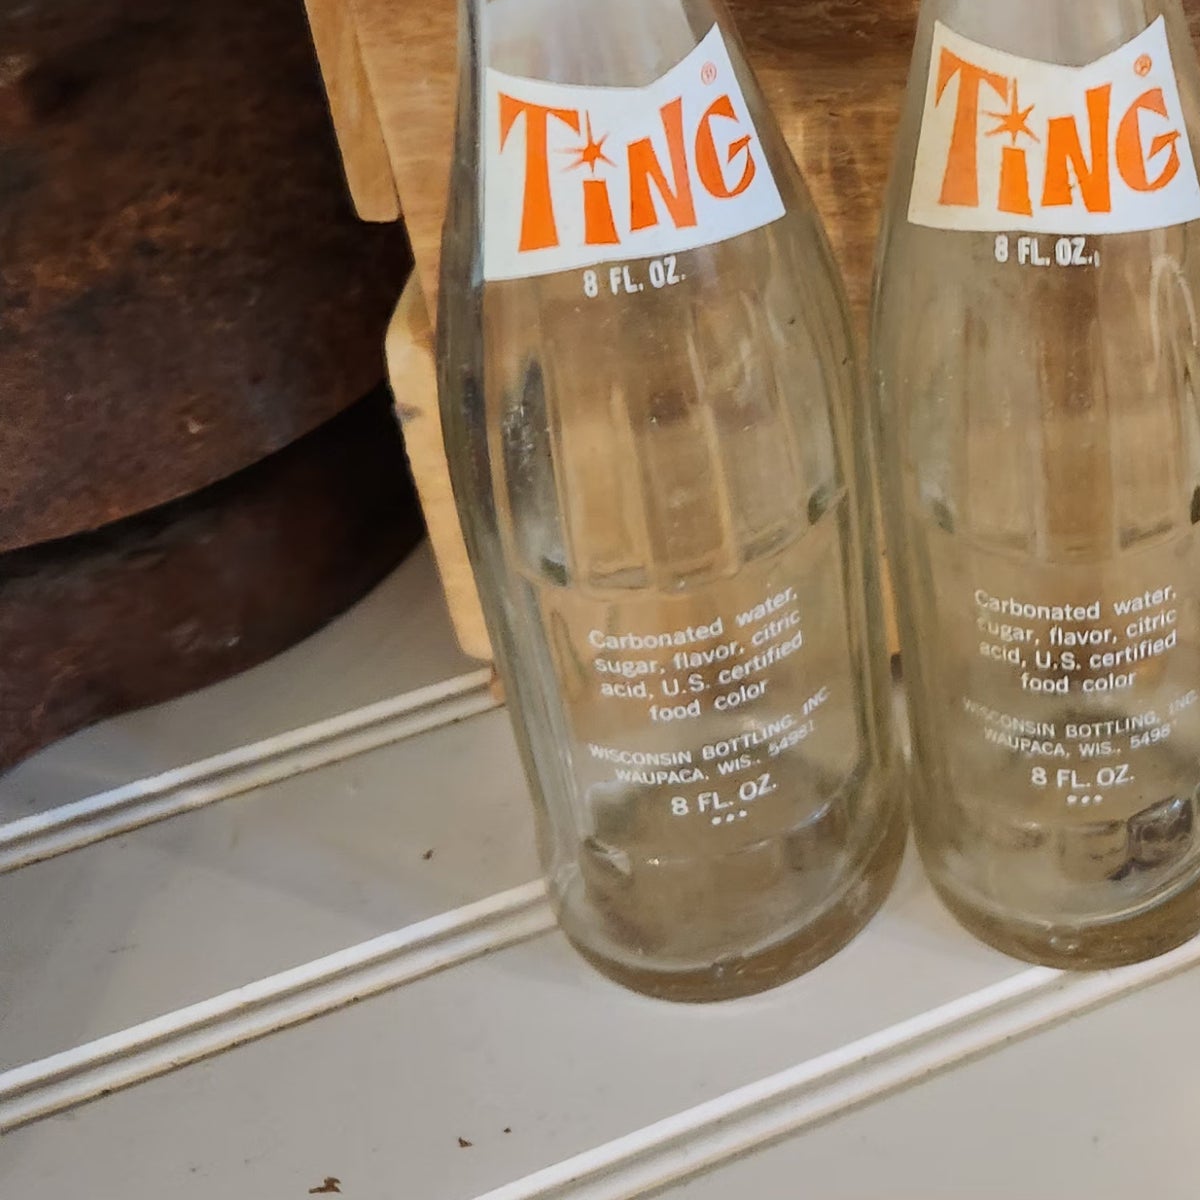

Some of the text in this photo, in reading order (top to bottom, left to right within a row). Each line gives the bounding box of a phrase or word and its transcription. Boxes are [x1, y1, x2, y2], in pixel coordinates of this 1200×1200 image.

[994, 234, 1009, 263] 8
[1017, 236, 1051, 267] FL.
[583, 255, 686, 298] 8 FL. OZ.
[974, 588, 1101, 622] Carbonated
[588, 617, 724, 650] Carbonated
[595, 609, 801, 678] sugar, flavor, citric
[1049, 624, 1118, 646] flavor,
[1126, 608, 1178, 639] citric
[601, 630, 803, 700] acid, U.S. certified
[979, 628, 1178, 671] acid, U.S. certified
[1020, 669, 1137, 693] food color
[650, 678, 769, 722] food color
[1130, 718, 1178, 750] 5498
[588, 742, 692, 766] WISCONSIN
[1031, 763, 1136, 789] 8 FL. OZ.
[671, 772, 777, 817] 8 FL. OZ.
